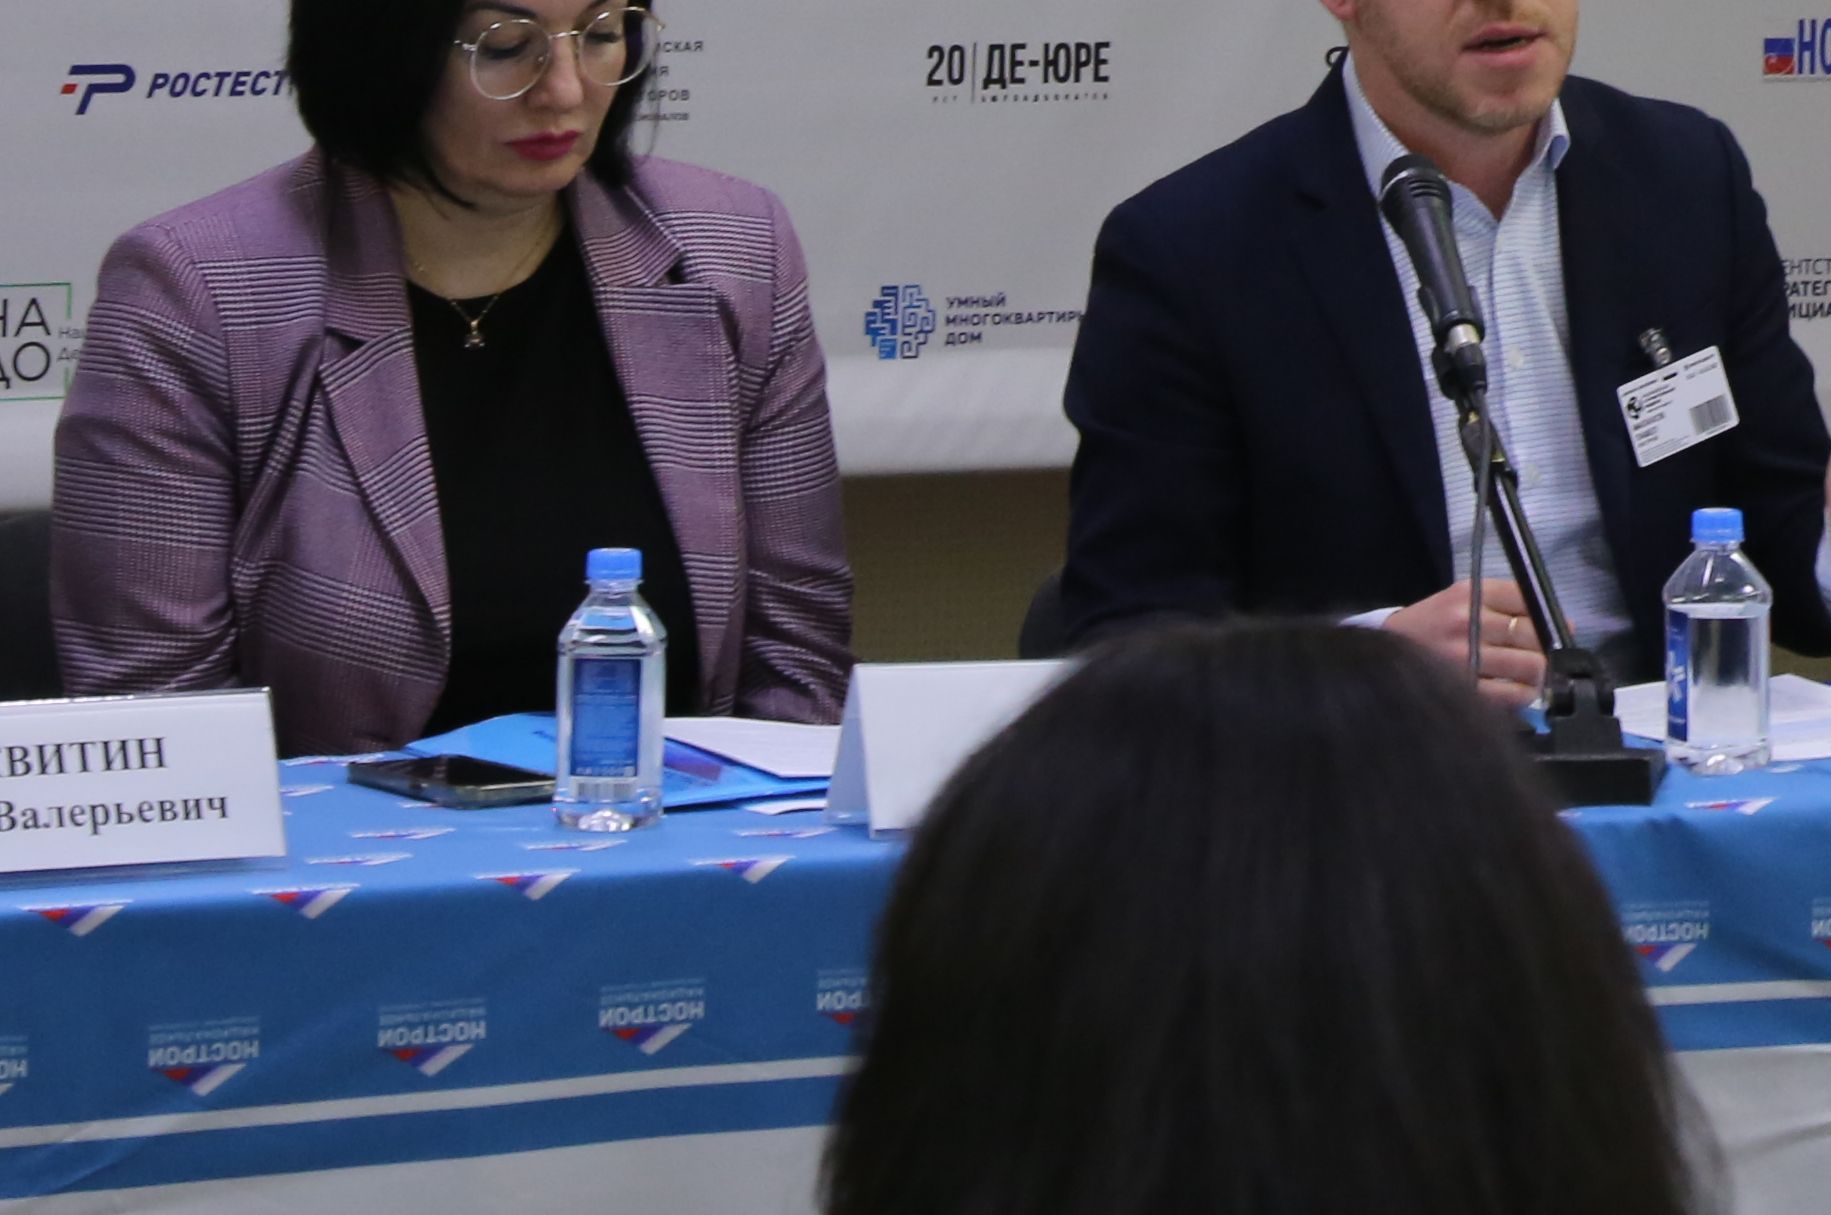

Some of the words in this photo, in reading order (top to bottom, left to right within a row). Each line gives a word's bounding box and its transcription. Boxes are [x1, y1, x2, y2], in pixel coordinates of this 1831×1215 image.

[926, 45, 965, 87] 20
[982, 42, 1111, 90] ДЕ-ЮРЕ
[945, 292, 1006, 309] УМНЫЙ
[945, 332, 983, 347] ДОМ
